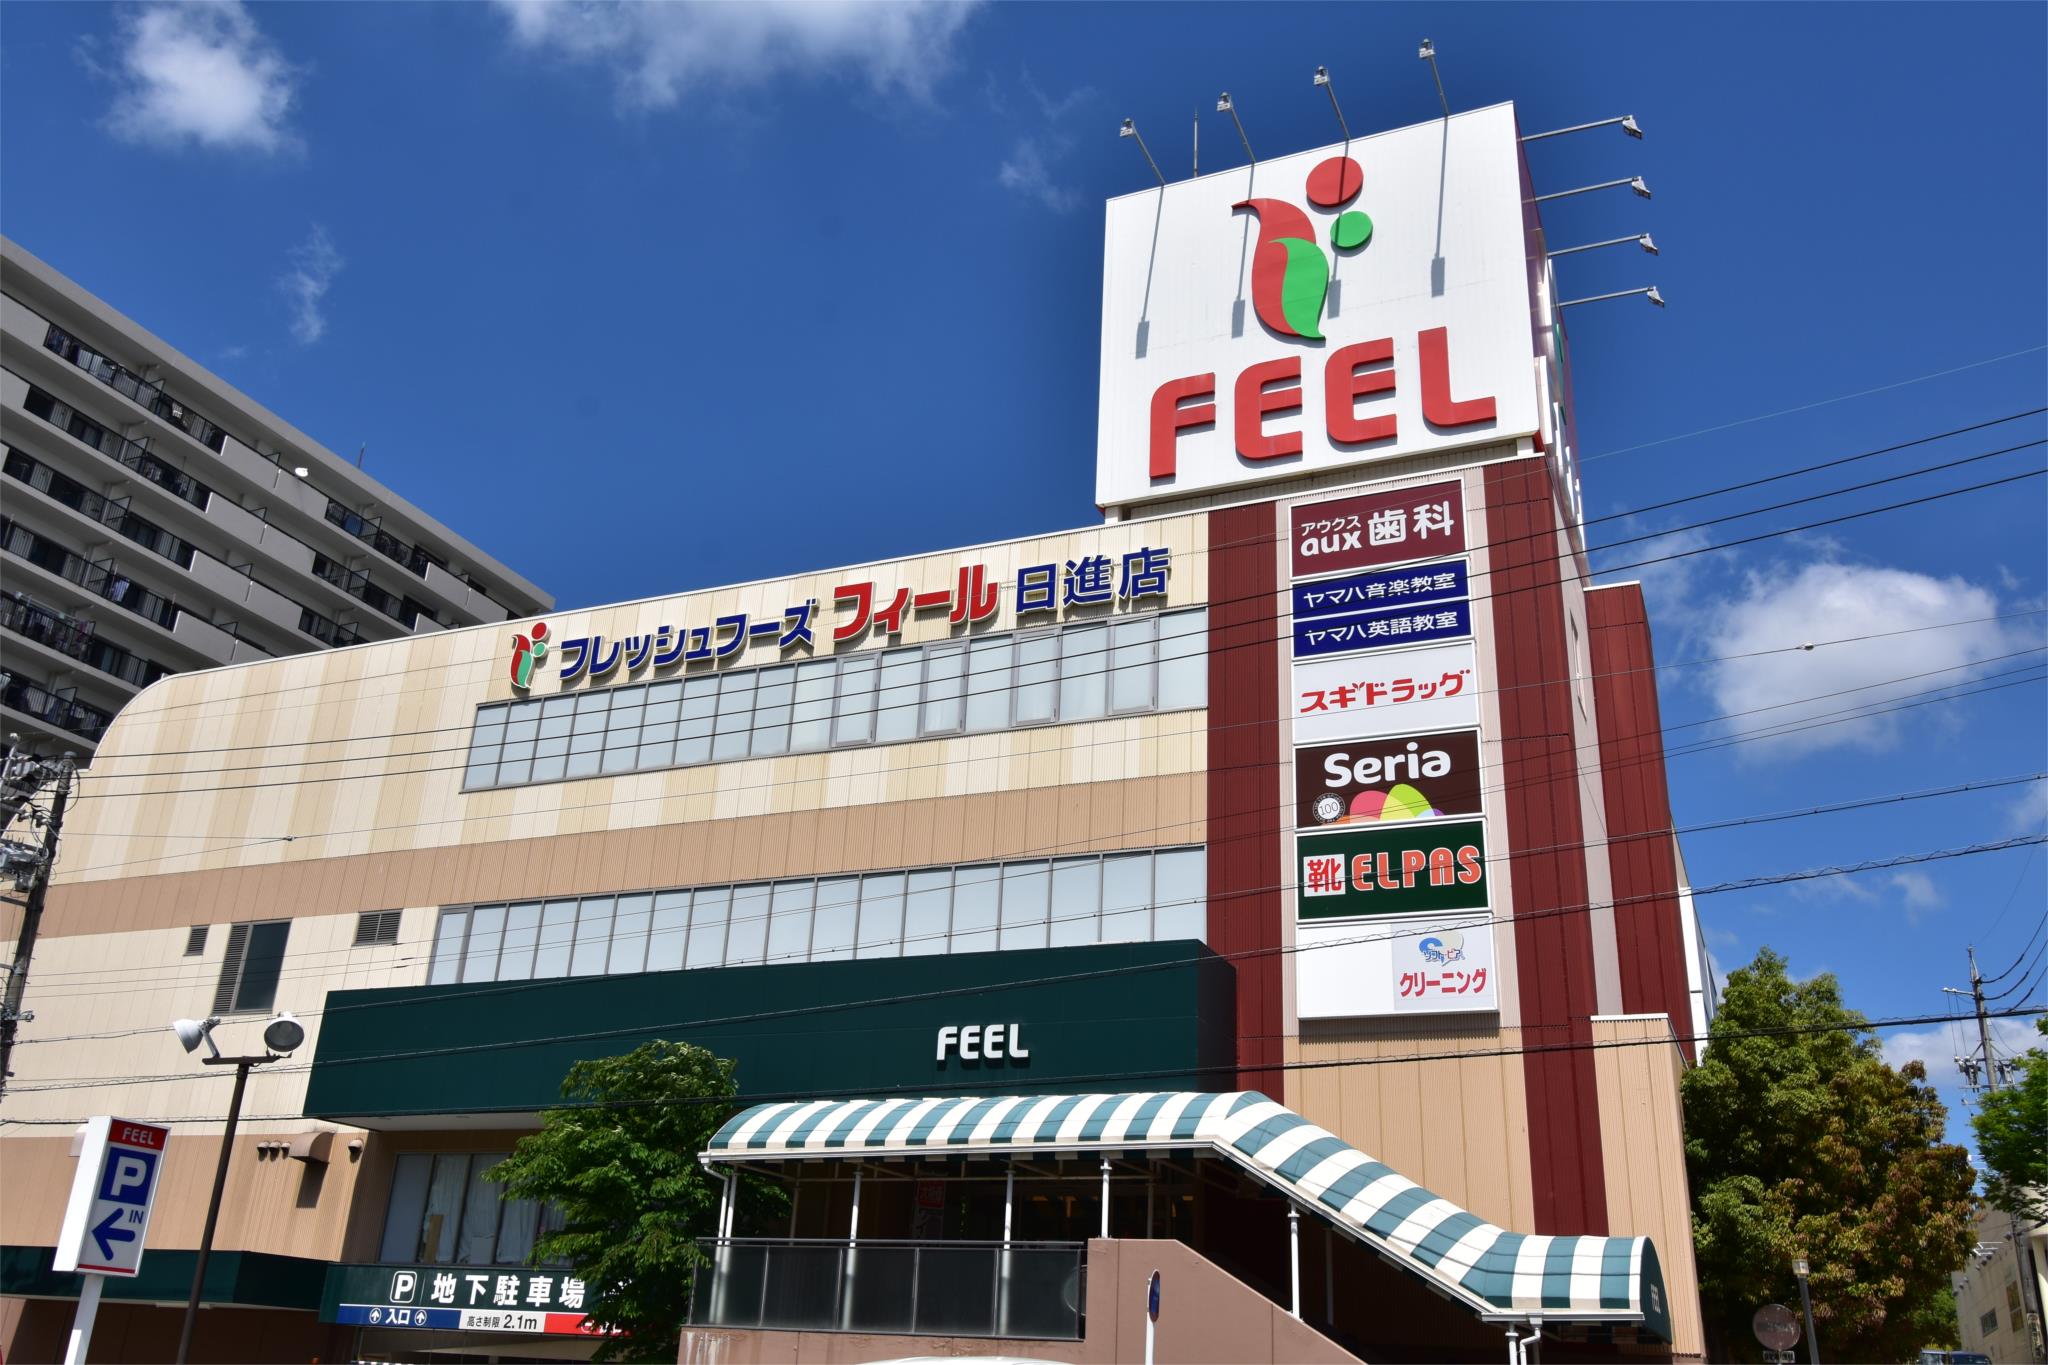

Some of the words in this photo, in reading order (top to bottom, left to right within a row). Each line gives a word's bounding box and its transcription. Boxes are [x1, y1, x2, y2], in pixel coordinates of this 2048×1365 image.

[1149, 326, 1497, 480] FEEL
[1300, 530, 1363, 557] aux
[1367, 500, 1455, 547] 歯科
[1301, 515, 1362, 536] アウクス
[1303, 572, 1457, 608] ヤマハ音楽教室
[559, 597, 818, 680] フレッシュフーズ
[832, 563, 999, 642] フィール
[1015, 546, 1170, 615] 日進店
[1305, 611, 1459, 646] ヤマハ英語教室
[1300, 669, 1471, 713] スギドラッグ
[1323, 741, 1452, 788] Seria
[1319, 801, 1339, 816] 100
[1307, 858, 1342, 893] 靴
[1351, 845, 1482, 892] ELPAS
[1399, 967, 1487, 997] クリーニング
[936, 1023, 1029, 1061] FEEL
[122, 1127, 154, 1145] FEEL
[110, 1155, 148, 1197] P
[129, 1210, 144, 1225] IN
[393, 1274, 414, 1300] P
[430, 1272, 586, 1310] 地下駐車場
[385, 1308, 411, 1325] 入口
[467, 1315, 501, 1328] 高さ制限
[503, 1313, 538, 1330] 2.1m
